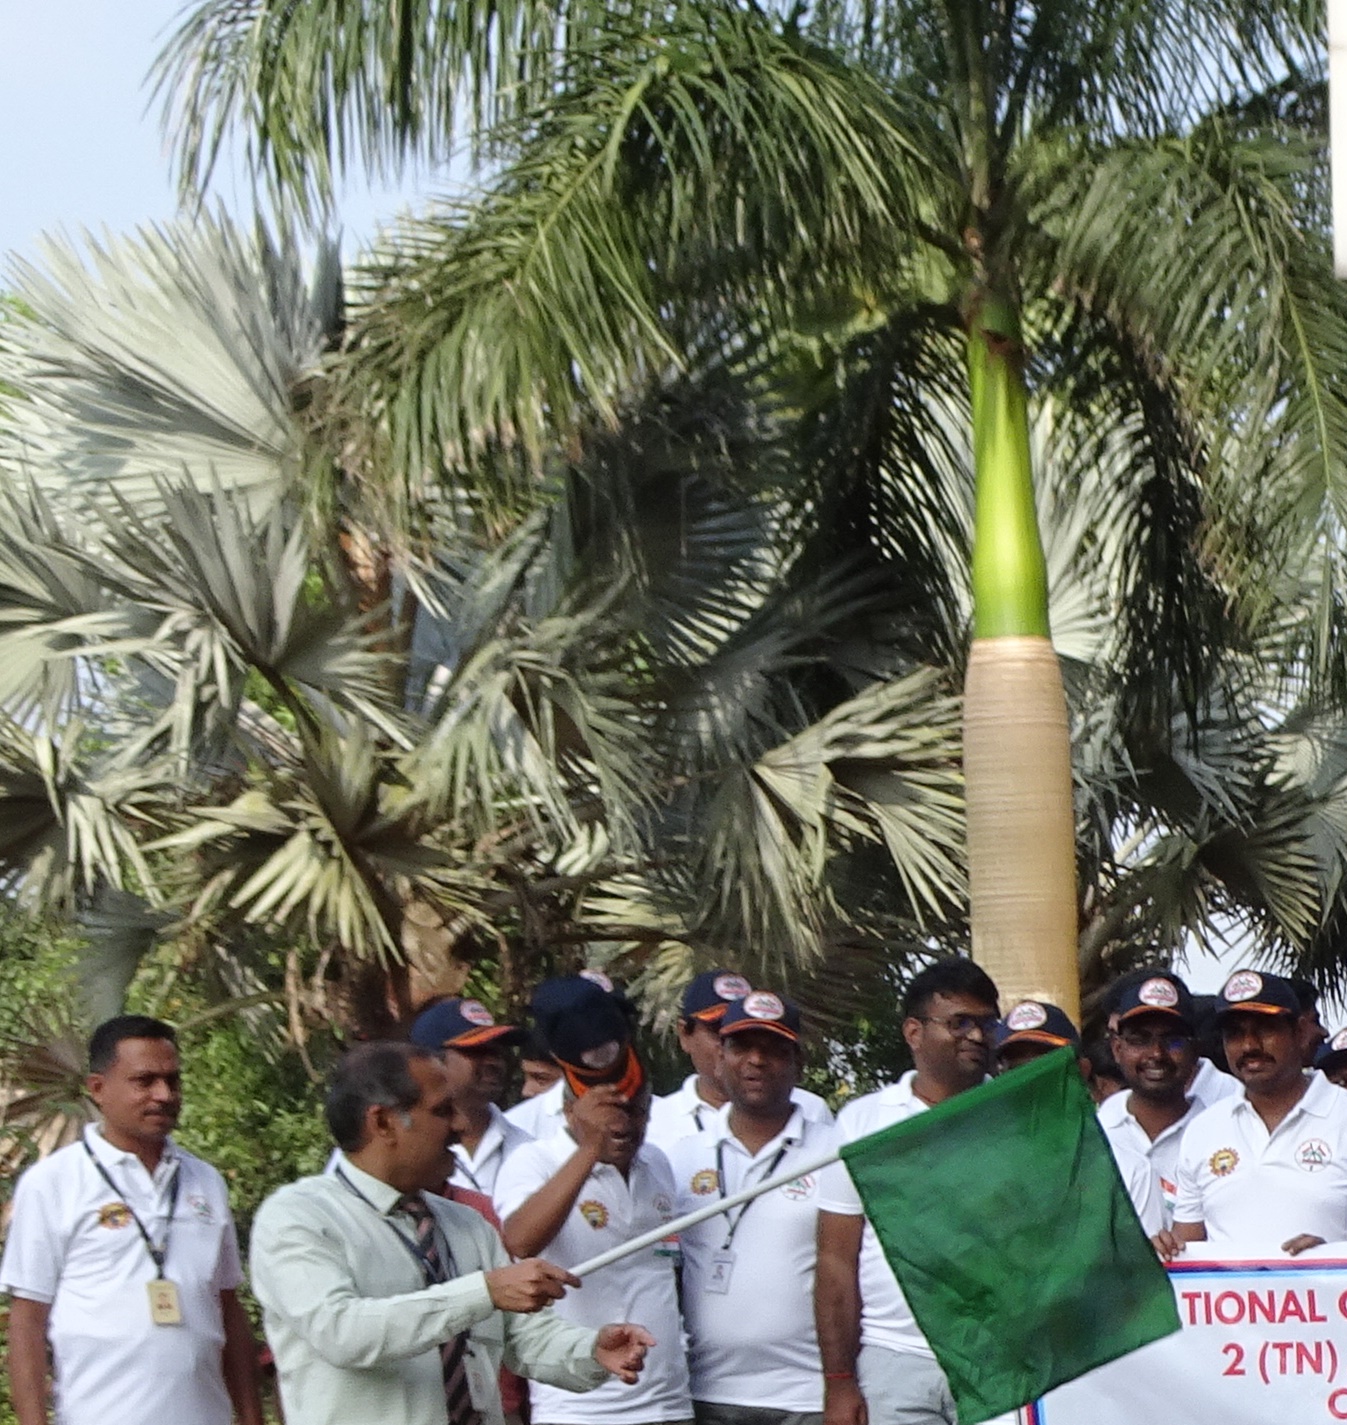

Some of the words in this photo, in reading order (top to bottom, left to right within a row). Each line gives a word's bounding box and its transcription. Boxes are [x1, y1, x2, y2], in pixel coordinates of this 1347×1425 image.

[1181, 1289, 1328, 1325] TIONAL
[1222, 1343, 1246, 1376] 2
[1258, 1340, 1338, 1385] (TN)
